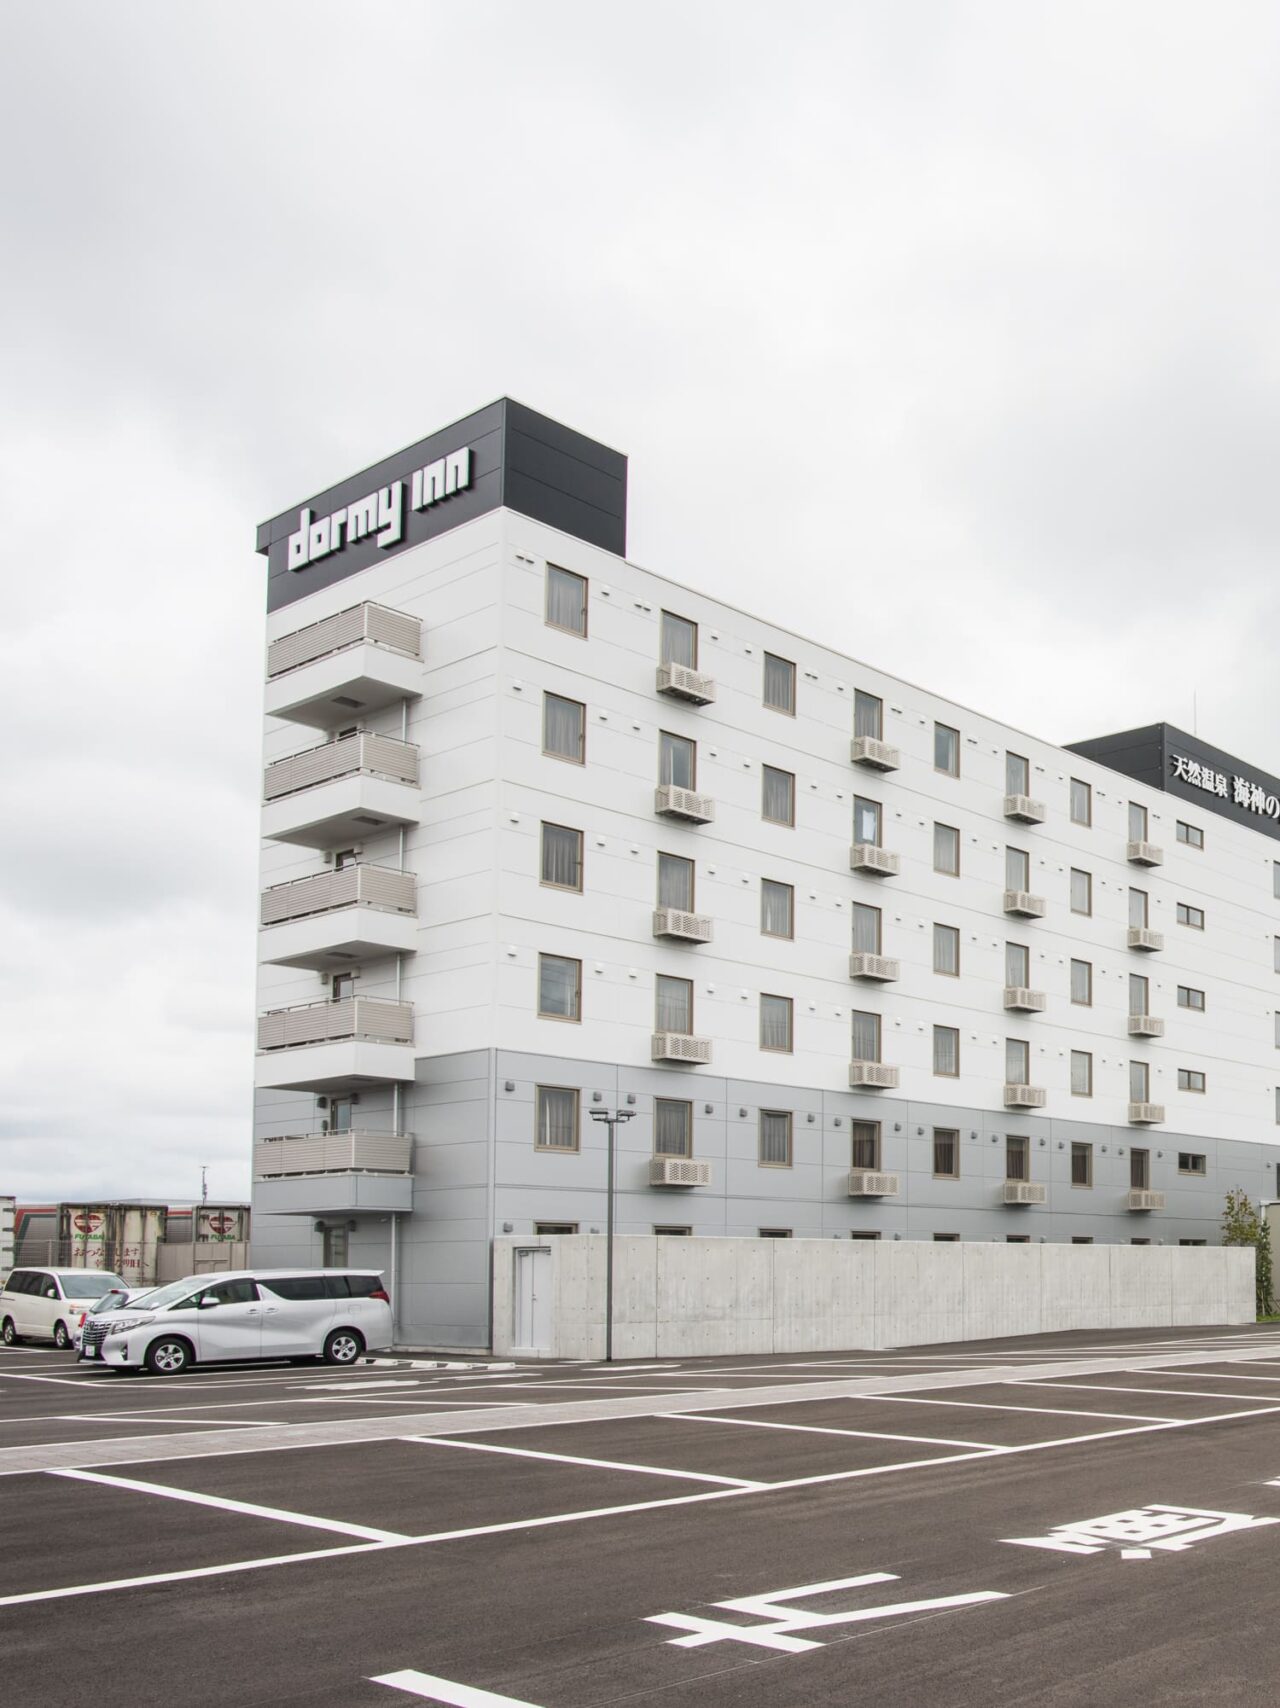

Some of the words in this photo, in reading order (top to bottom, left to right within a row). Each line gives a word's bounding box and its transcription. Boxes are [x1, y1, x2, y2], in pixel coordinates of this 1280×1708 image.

[288, 480, 403, 571] dormy
[413, 446, 474, 512] inn
[1173, 754, 1228, 798] 天然温泉
